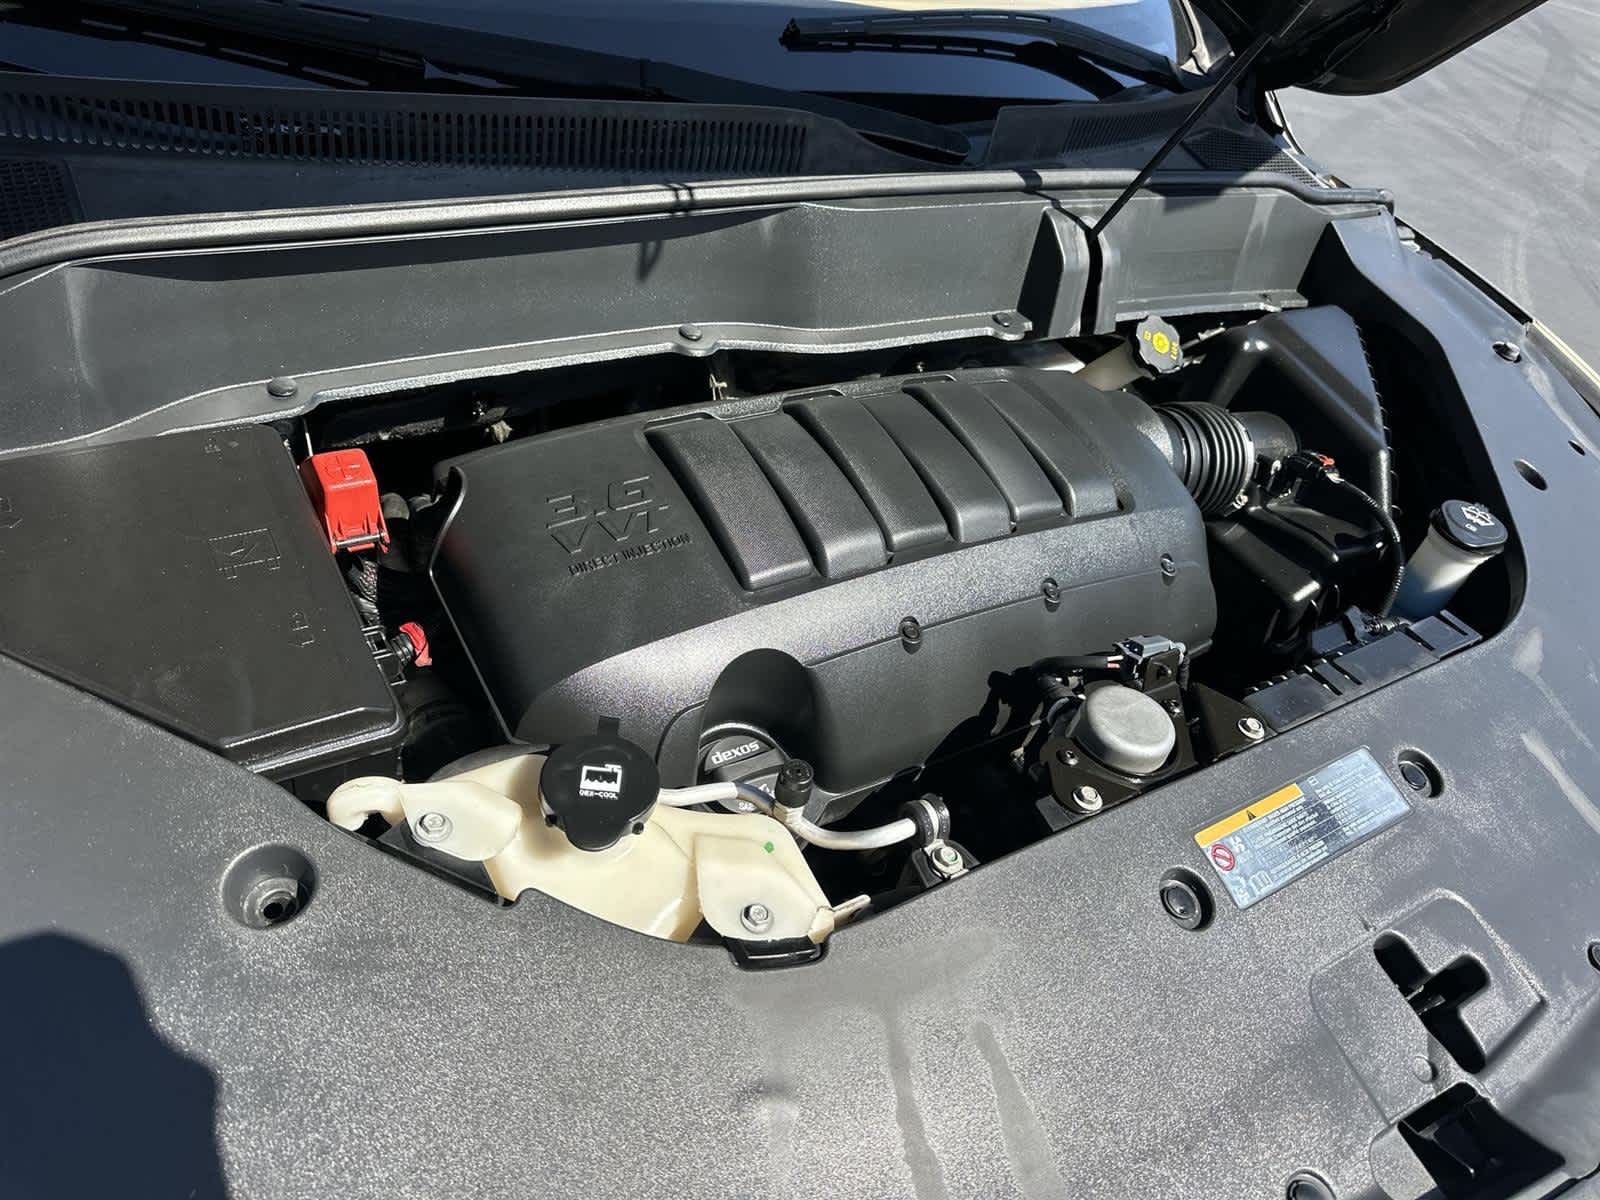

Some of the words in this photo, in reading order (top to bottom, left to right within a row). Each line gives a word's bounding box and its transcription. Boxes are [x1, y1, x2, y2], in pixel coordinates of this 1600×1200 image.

[549, 505, 670, 555] VVT
[567, 552, 620, 577] DIRECT
[622, 533, 693, 560] INJECTION
[711, 740, 761, 765] dexos
